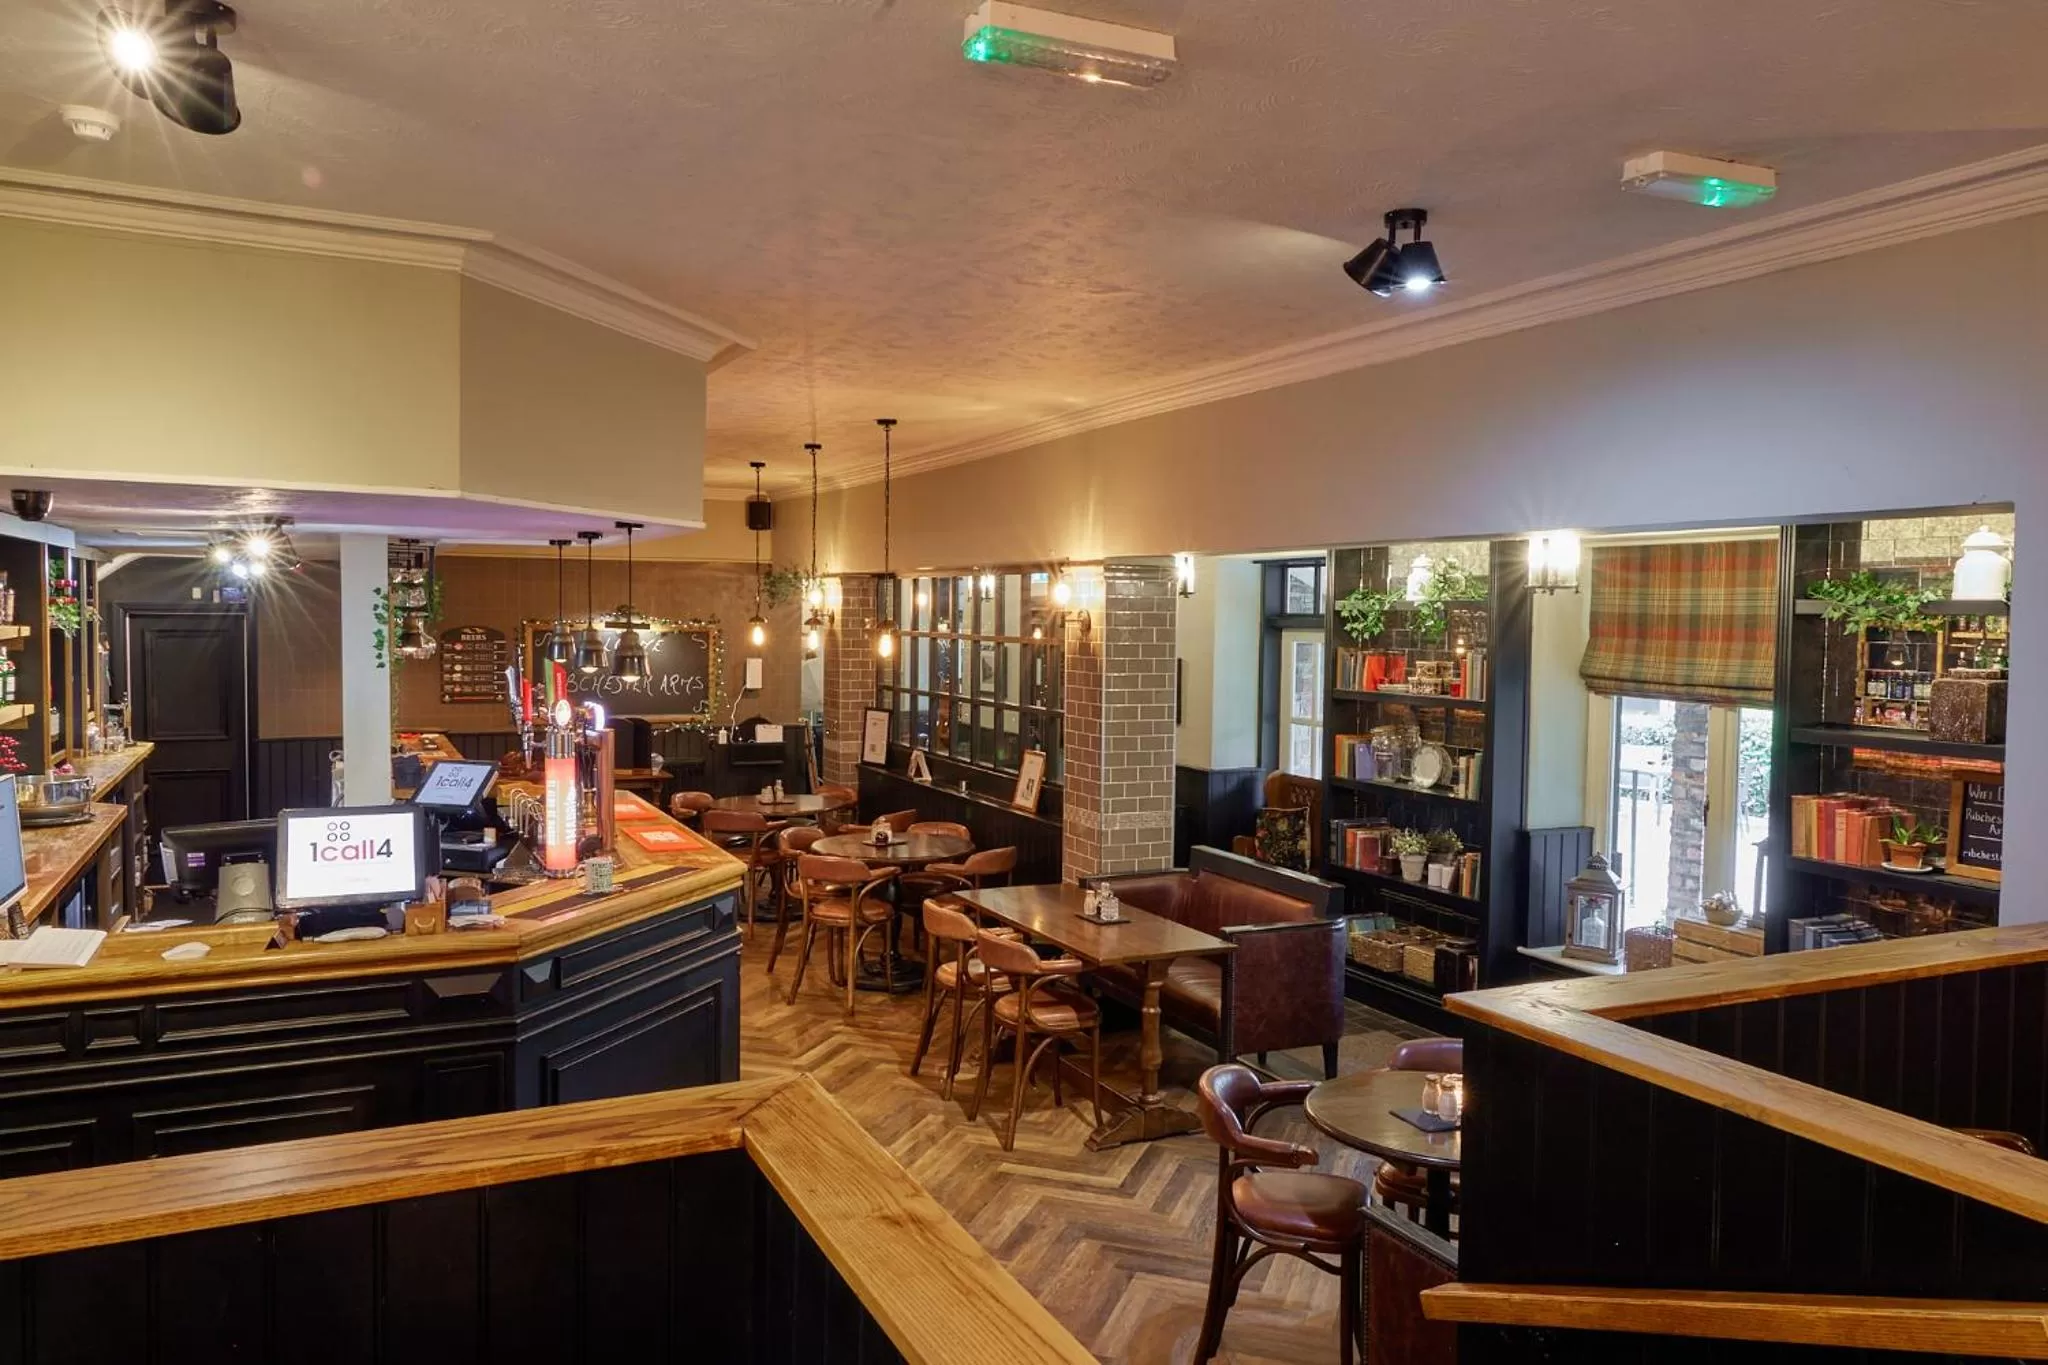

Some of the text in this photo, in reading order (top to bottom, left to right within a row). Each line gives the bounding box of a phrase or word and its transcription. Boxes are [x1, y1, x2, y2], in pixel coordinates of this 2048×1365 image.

[567, 673, 654, 697] BCHESTER
[660, 674, 705, 696] ARMS
[1965, 807, 2003, 824] Ribches
[309, 838, 393, 862] 1call4
[1962, 848, 2002, 861] ribchest
